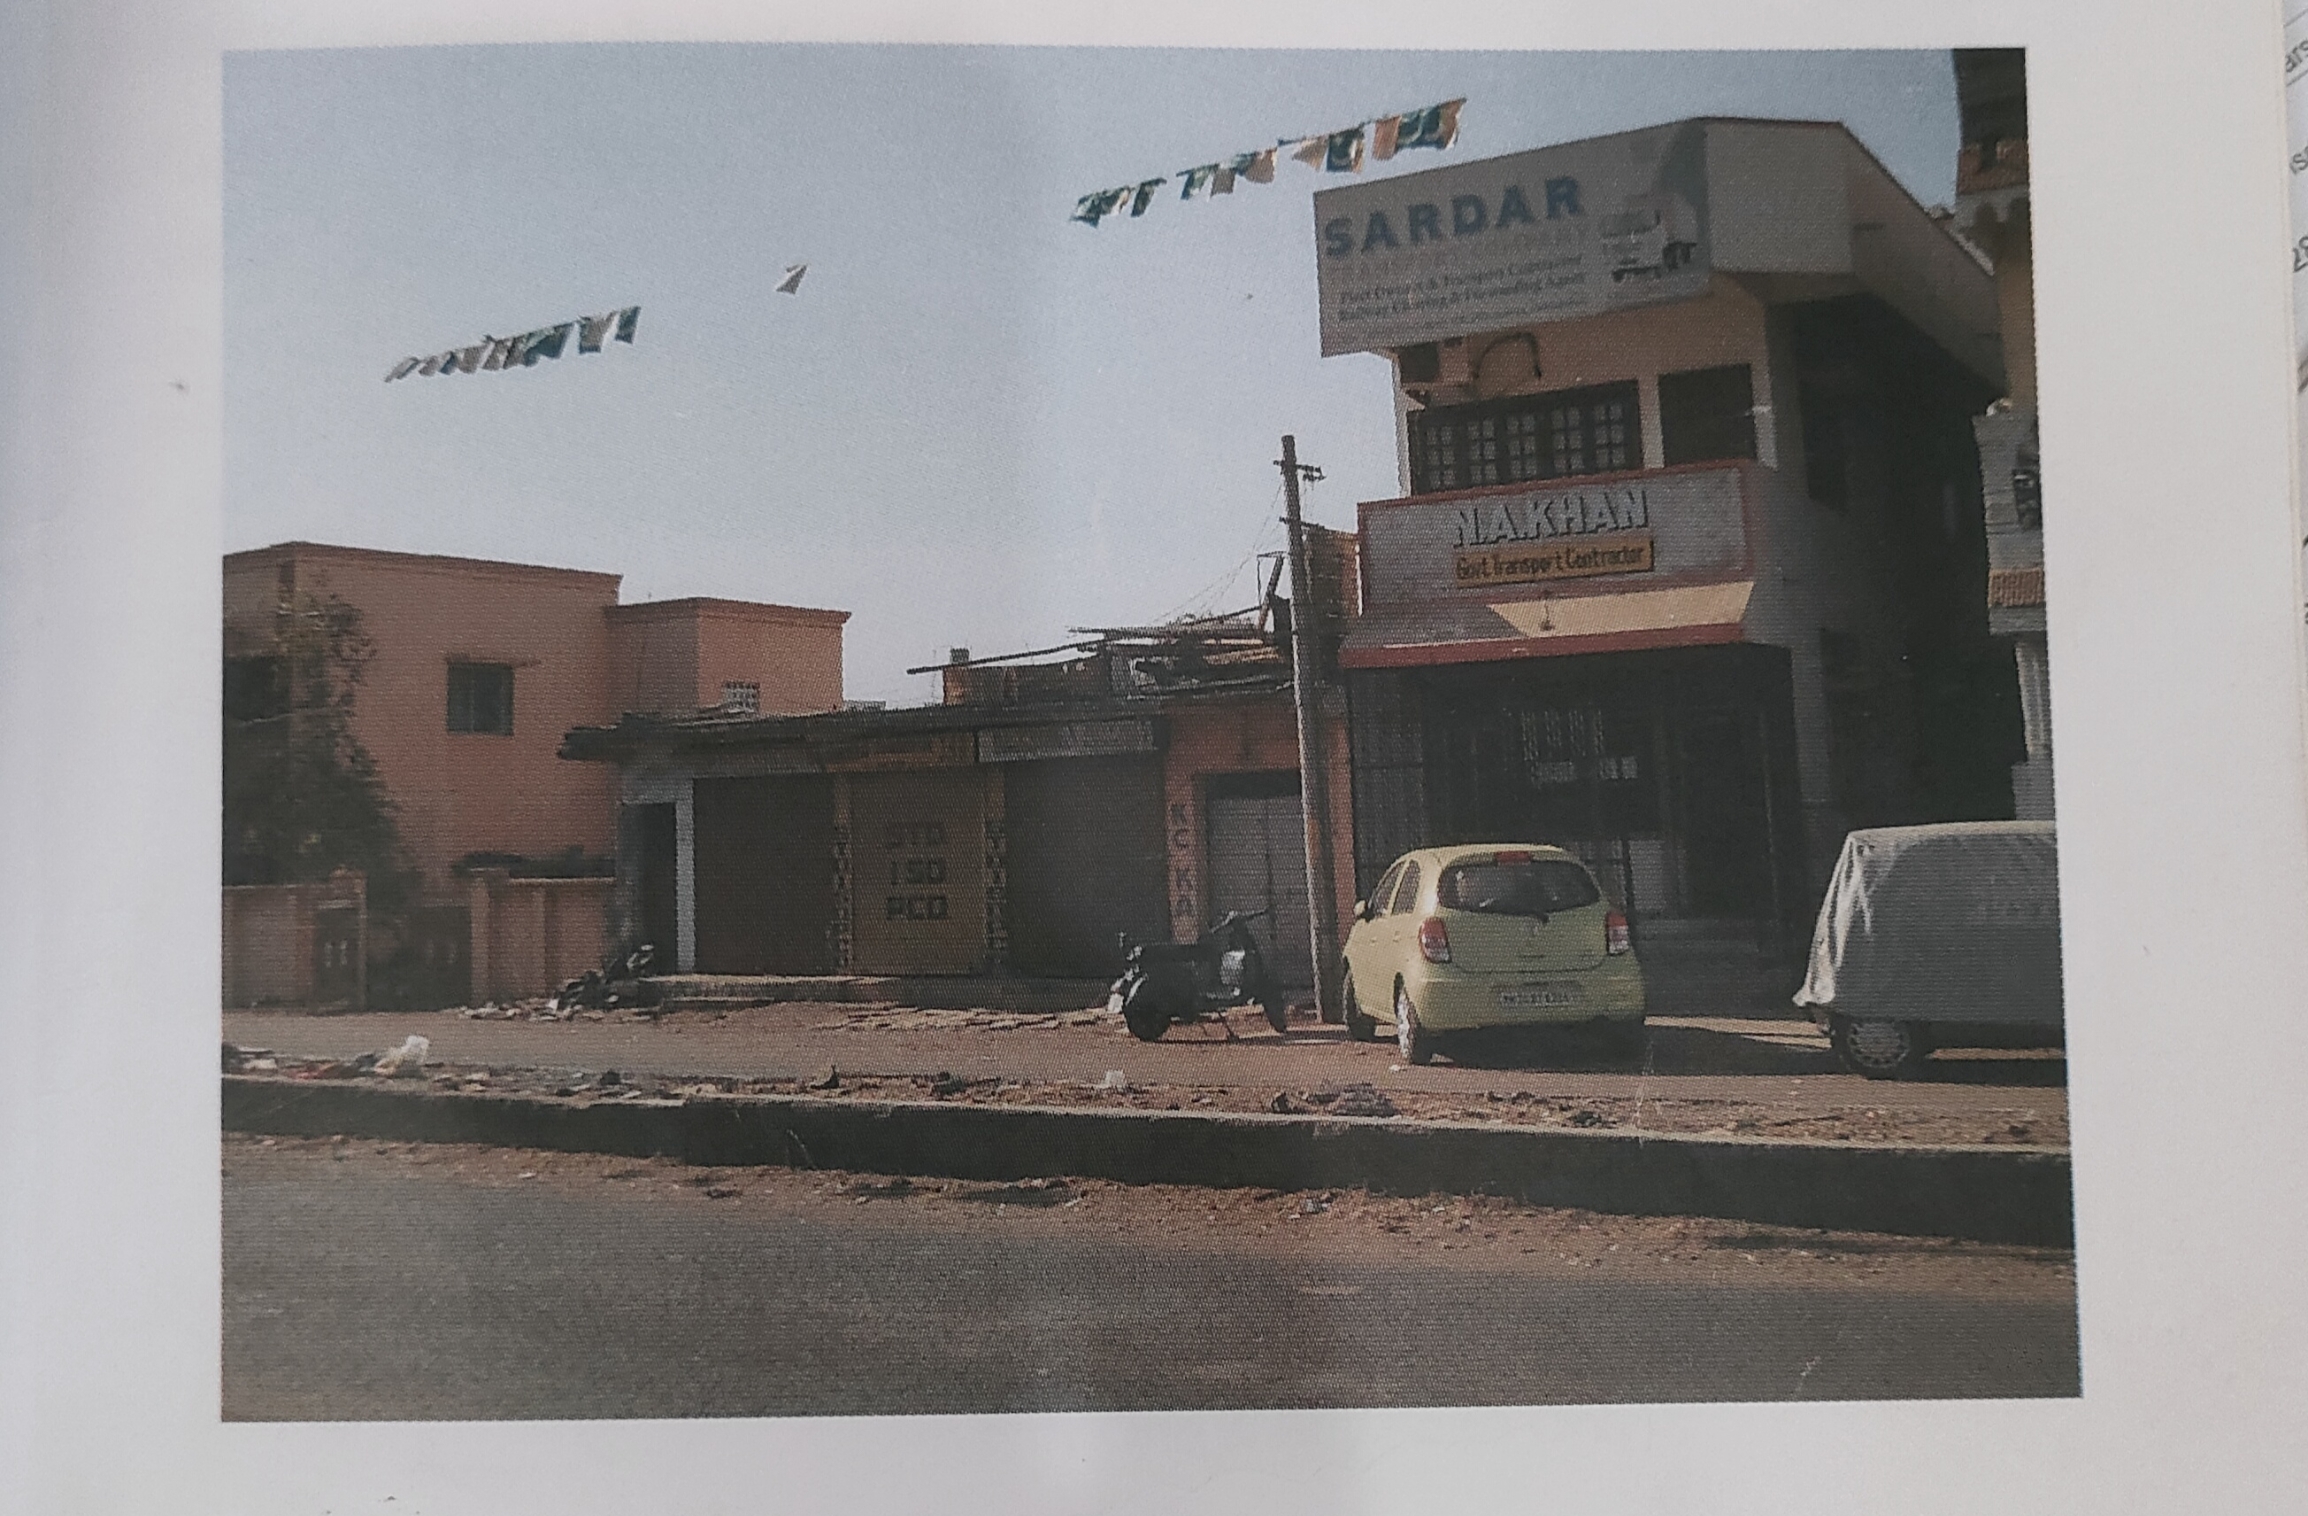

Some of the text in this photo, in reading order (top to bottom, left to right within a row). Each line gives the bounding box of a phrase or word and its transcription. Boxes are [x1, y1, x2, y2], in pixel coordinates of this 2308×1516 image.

[1324, 175, 1586, 260] SARDAR
[1492, 551, 1564, 578] Transport
[1566, 545, 1645, 570] Contractor
